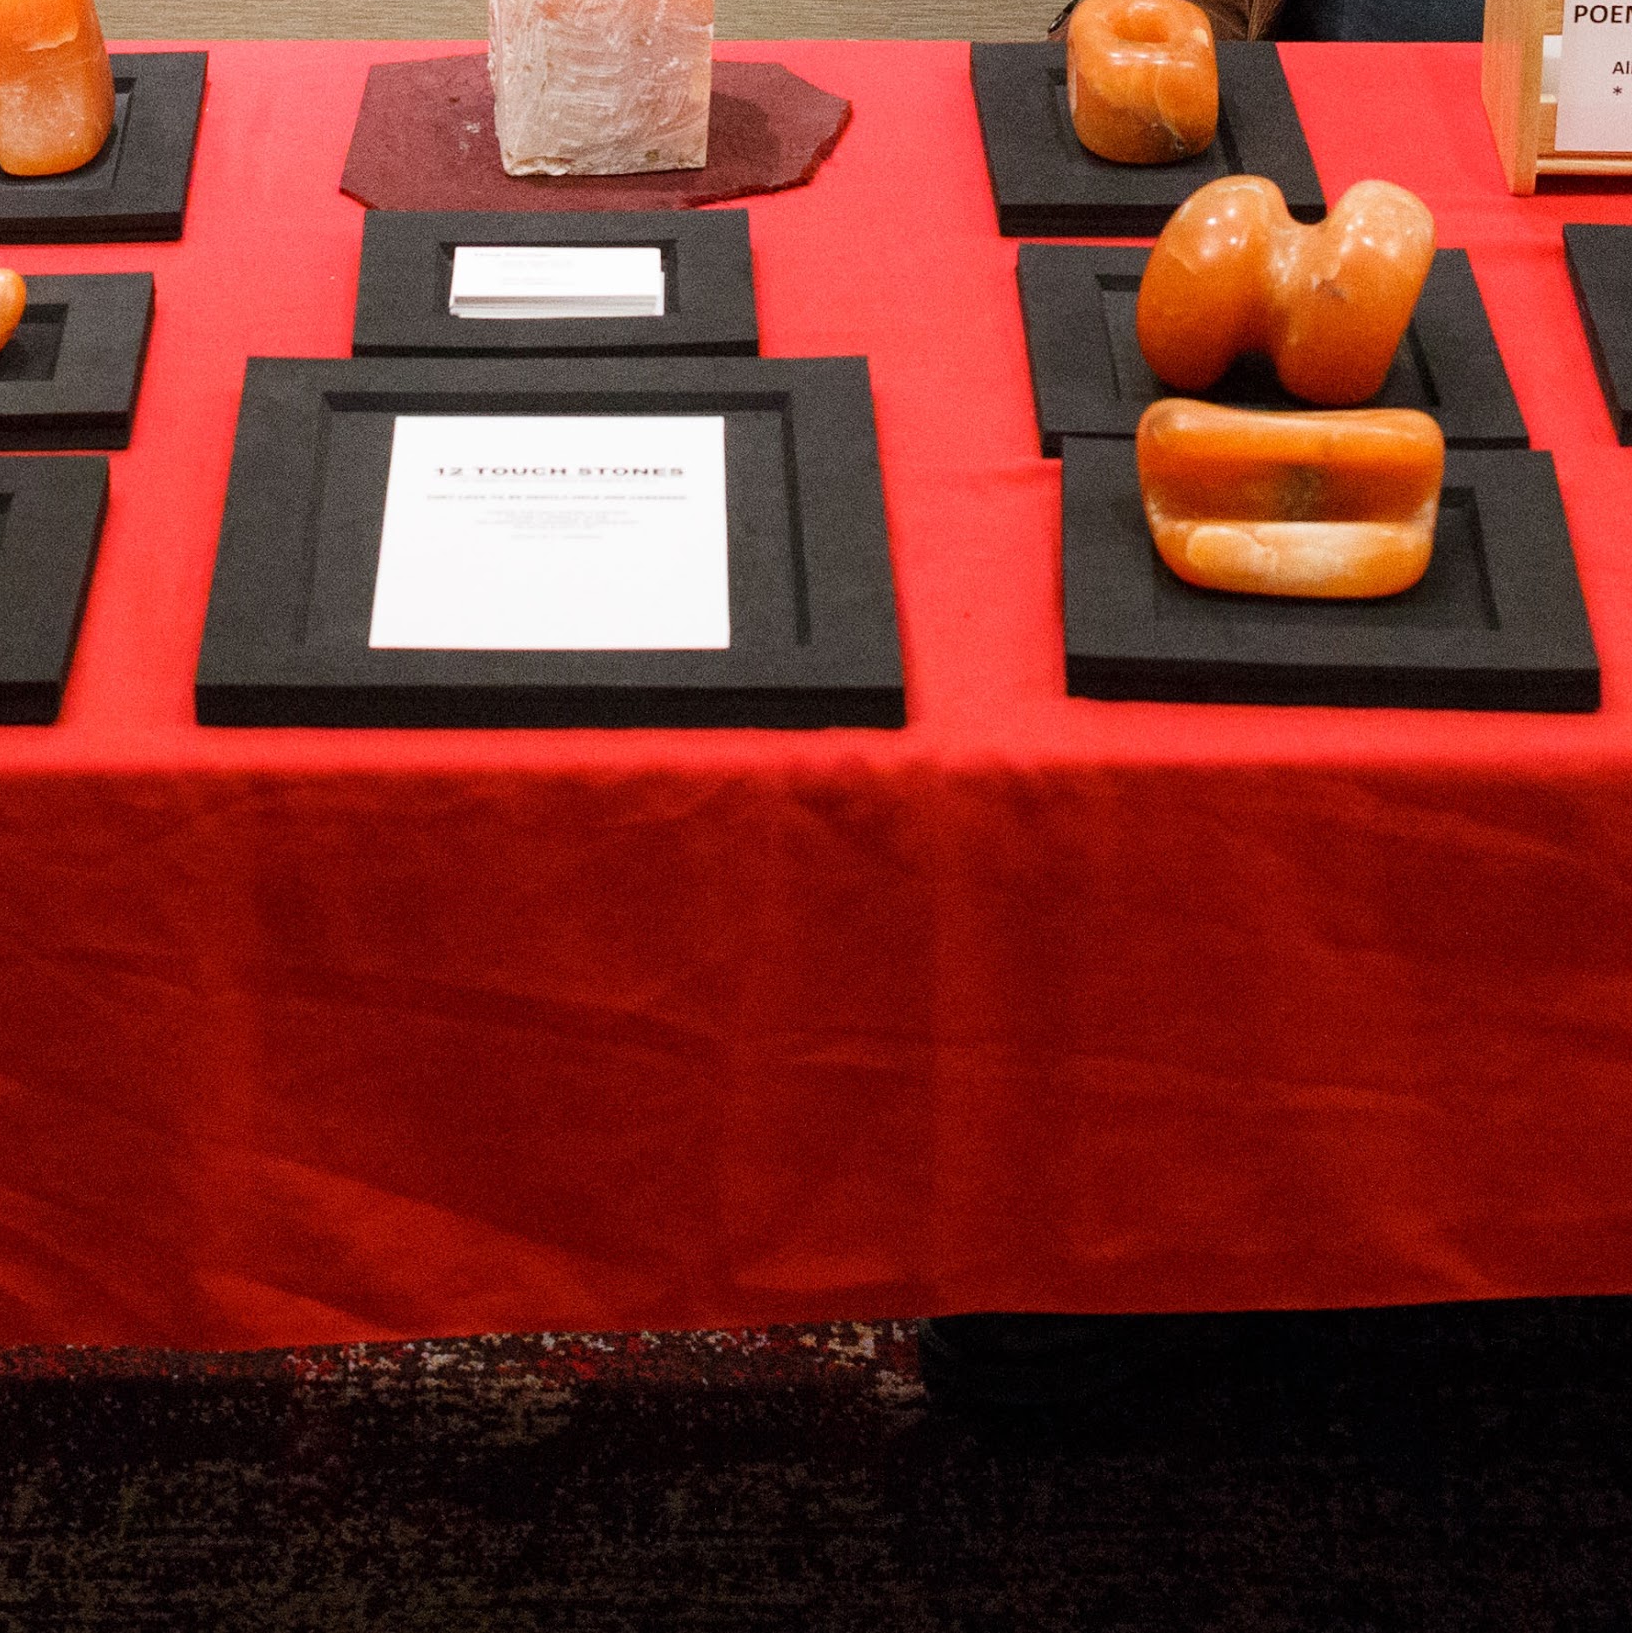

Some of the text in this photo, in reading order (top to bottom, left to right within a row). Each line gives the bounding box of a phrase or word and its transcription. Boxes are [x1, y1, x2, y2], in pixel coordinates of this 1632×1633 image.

[435, 467, 685, 477] 12 TOUCH STONES
